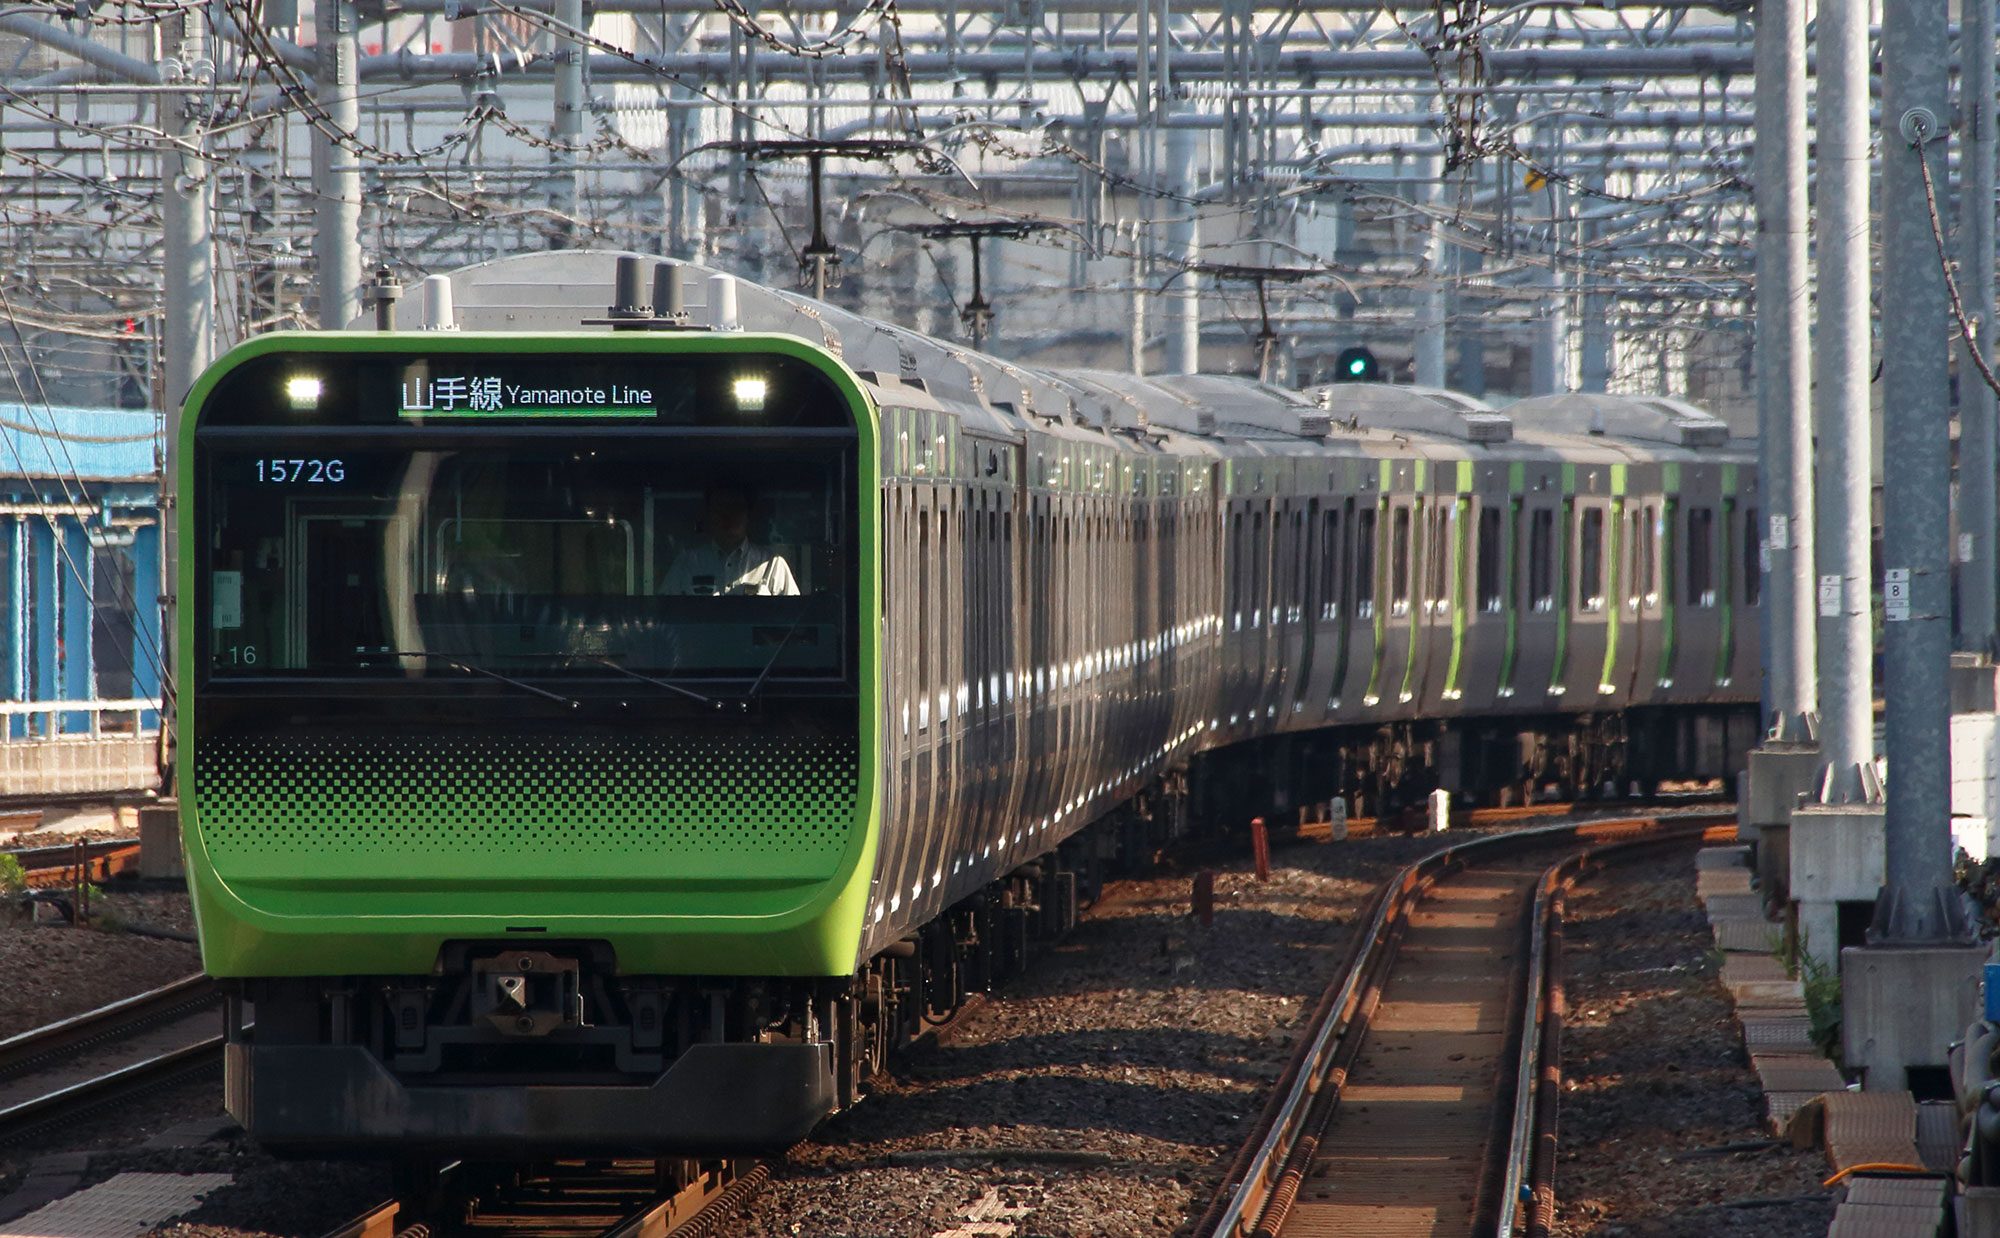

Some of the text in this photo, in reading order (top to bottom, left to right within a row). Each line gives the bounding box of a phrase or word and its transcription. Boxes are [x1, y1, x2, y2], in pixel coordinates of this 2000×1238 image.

[402, 376, 652, 411] 山手線 Yamanote Line
[255, 459, 345, 483] 1572G
[1892, 585, 1900, 597] 8
[229, 645, 257, 664] 16
